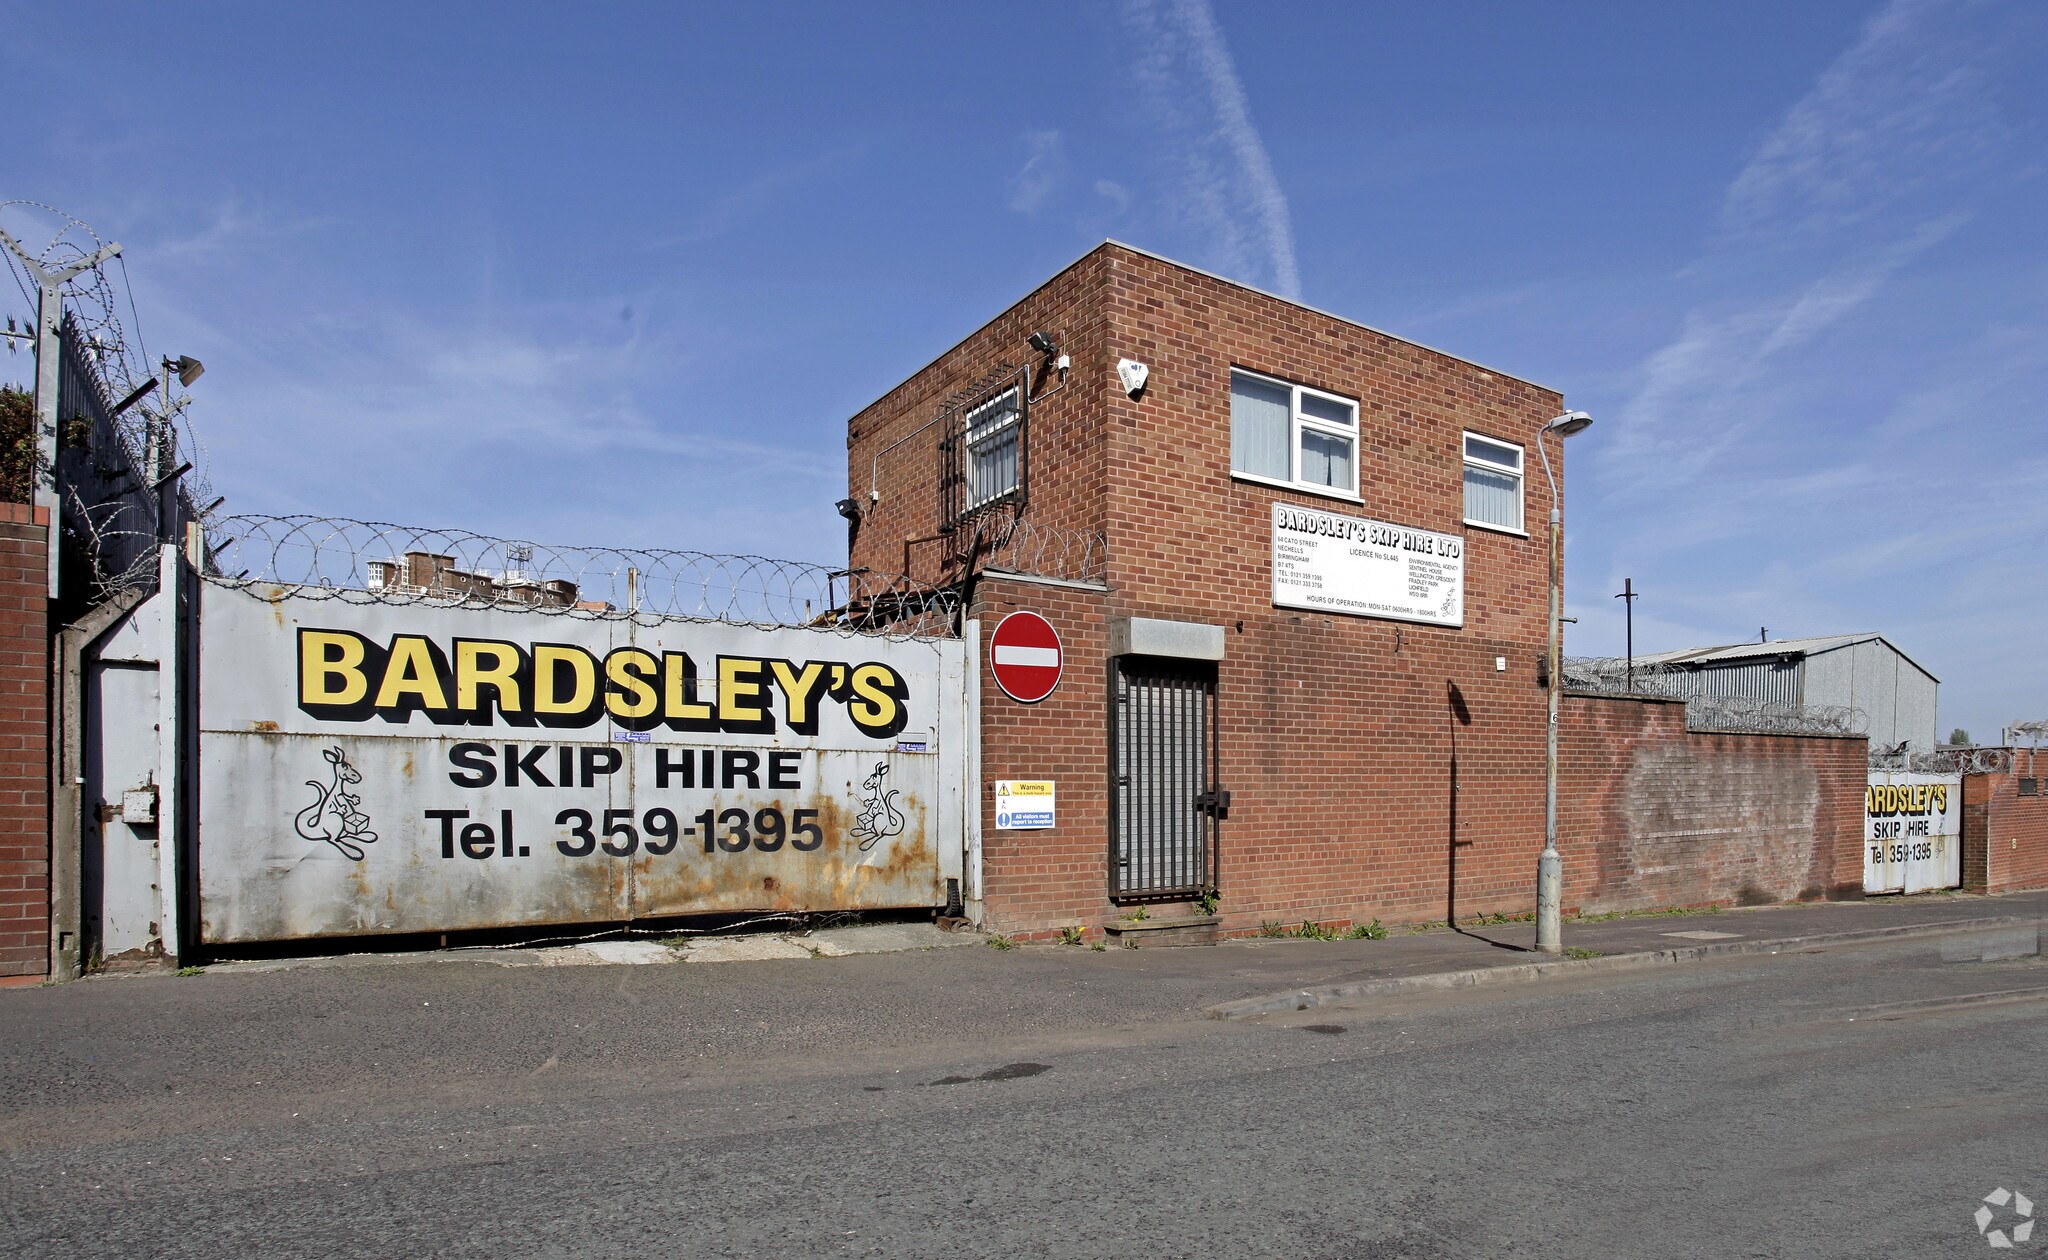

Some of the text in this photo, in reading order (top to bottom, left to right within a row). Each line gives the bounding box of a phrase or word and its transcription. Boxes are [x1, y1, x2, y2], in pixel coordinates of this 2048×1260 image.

[1277, 508, 1460, 559] BARDSLEY'S SKIP HIRE LTD
[1284, 537, 1299, 545] CATO
[1299, 540, 1318, 548] STREET
[1277, 545, 1304, 554] NECHELLS
[1349, 548, 1399, 562] LICENCE No SL445
[1277, 553, 1310, 563] BIRMINGHAM
[1290, 571, 1301, 579] 0121
[1408, 565, 1428, 573] SENTINEL
[1408, 571, 1456, 583] WELLINGTON CRESCENT
[1408, 578, 1428, 586] FRADLEY
[1306, 595, 1326, 603] HOURS
[1368, 603, 1391, 612] MON-SAT
[297, 627, 908, 739] BARDSLEY'S
[1553, 713, 1559, 722] 6
[449, 742, 802, 790] SKIP HIRE
[1019, 783, 1045, 791] Warning
[425, 807, 825, 860] Tel. 359-1395
[1873, 820, 1929, 838] SKIP HIRE
[1889, 842, 1932, 863] 359-1395
